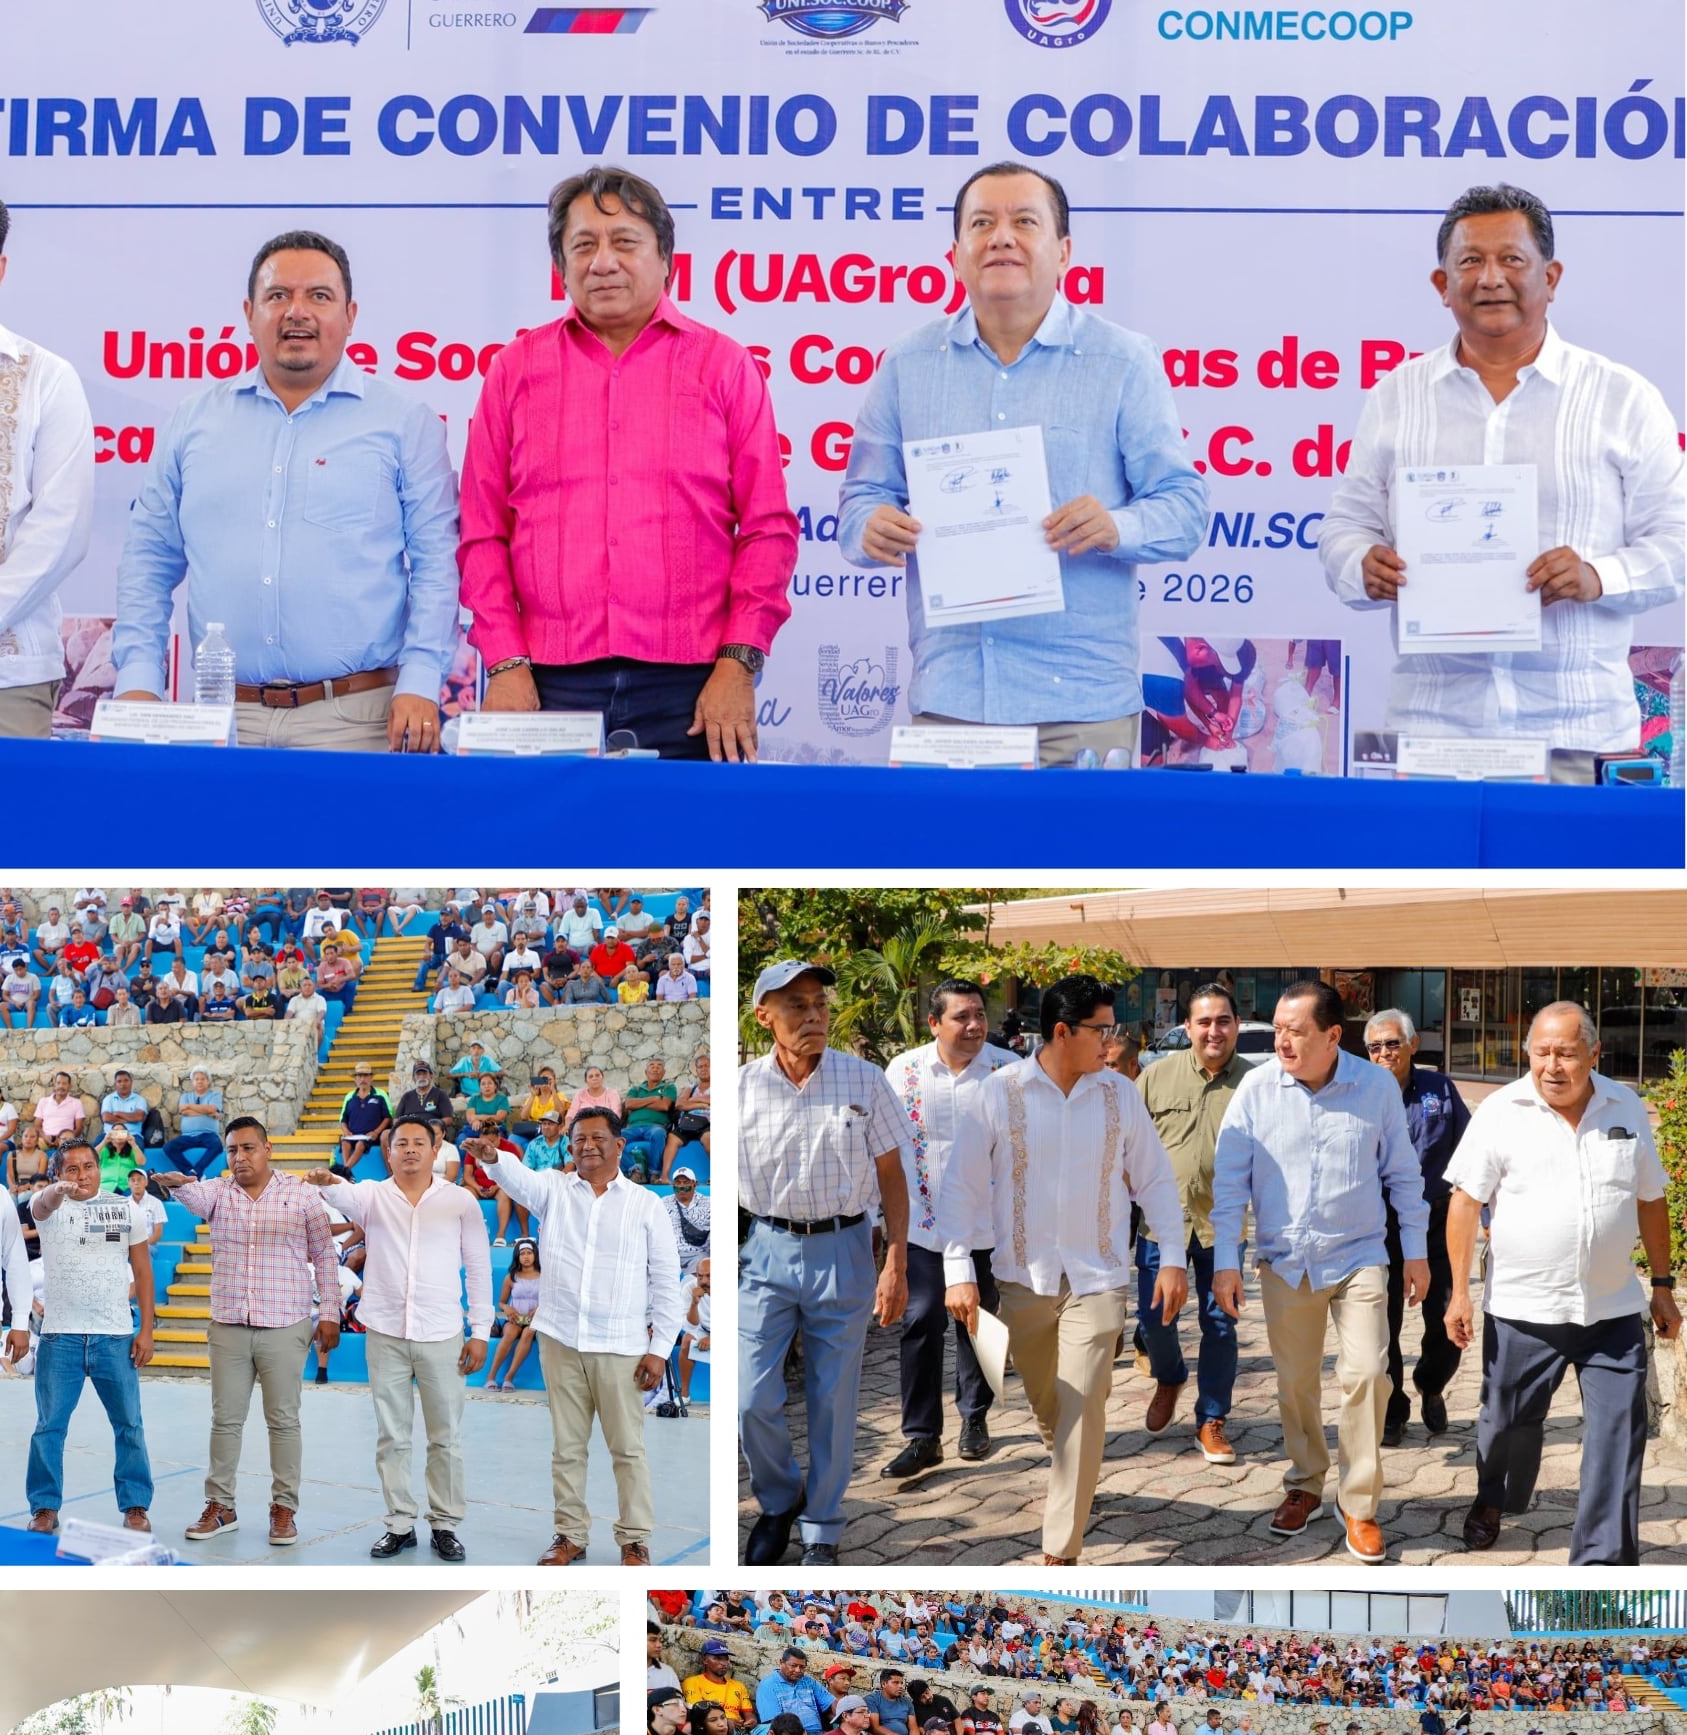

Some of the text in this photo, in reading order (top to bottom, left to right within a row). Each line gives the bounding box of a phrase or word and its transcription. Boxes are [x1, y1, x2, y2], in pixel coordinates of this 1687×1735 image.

[428, 13, 517, 28] GUERRERO
[1157, 10, 1414, 42] CONMECOOP
[1026, 30, 1086, 49] UAGro
[244, 97, 351, 156] DE
[377, 93, 837, 157] CONVENIO
[867, 95, 979, 156] DE
[1007, 78, 1685, 160] COLABORACIÓ
[712, 187, 925, 221] ENTRE
[715, 249, 966, 314] (UAGro)
[103, 326, 259, 379] Unió
[1257, 335, 1340, 389] de
[793, 574, 902, 598] uerrer
[1163, 573, 1254, 603] 2026
[822, 675, 902, 706] Valores
